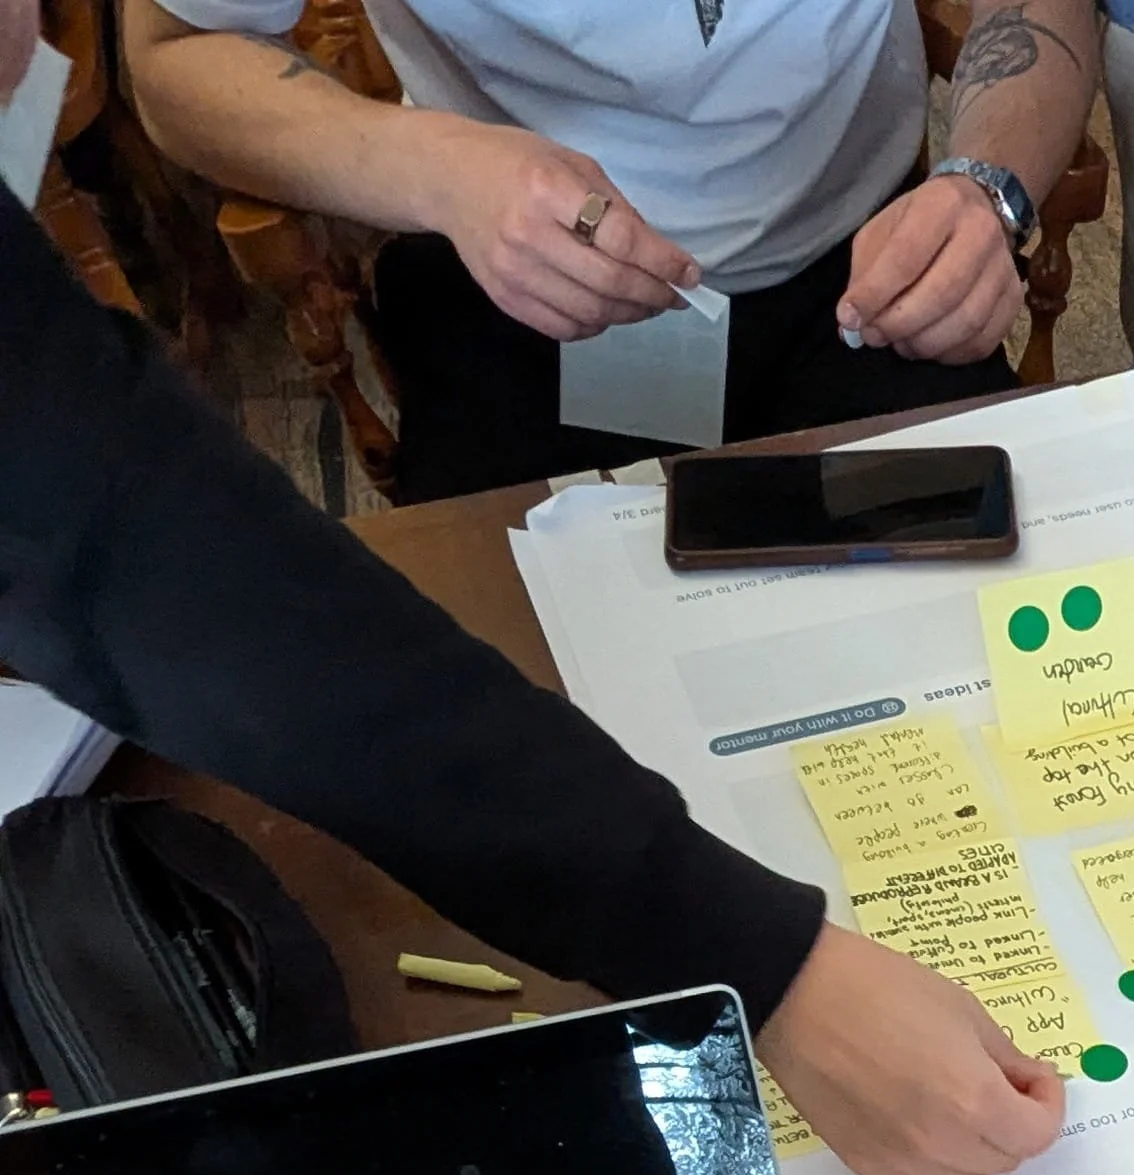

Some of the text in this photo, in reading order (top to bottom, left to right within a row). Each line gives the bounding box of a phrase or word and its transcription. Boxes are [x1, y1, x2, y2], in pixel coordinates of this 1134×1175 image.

[923, 683, 973, 702] ideas
[716, 706, 877, 751] Do it with your mentor
